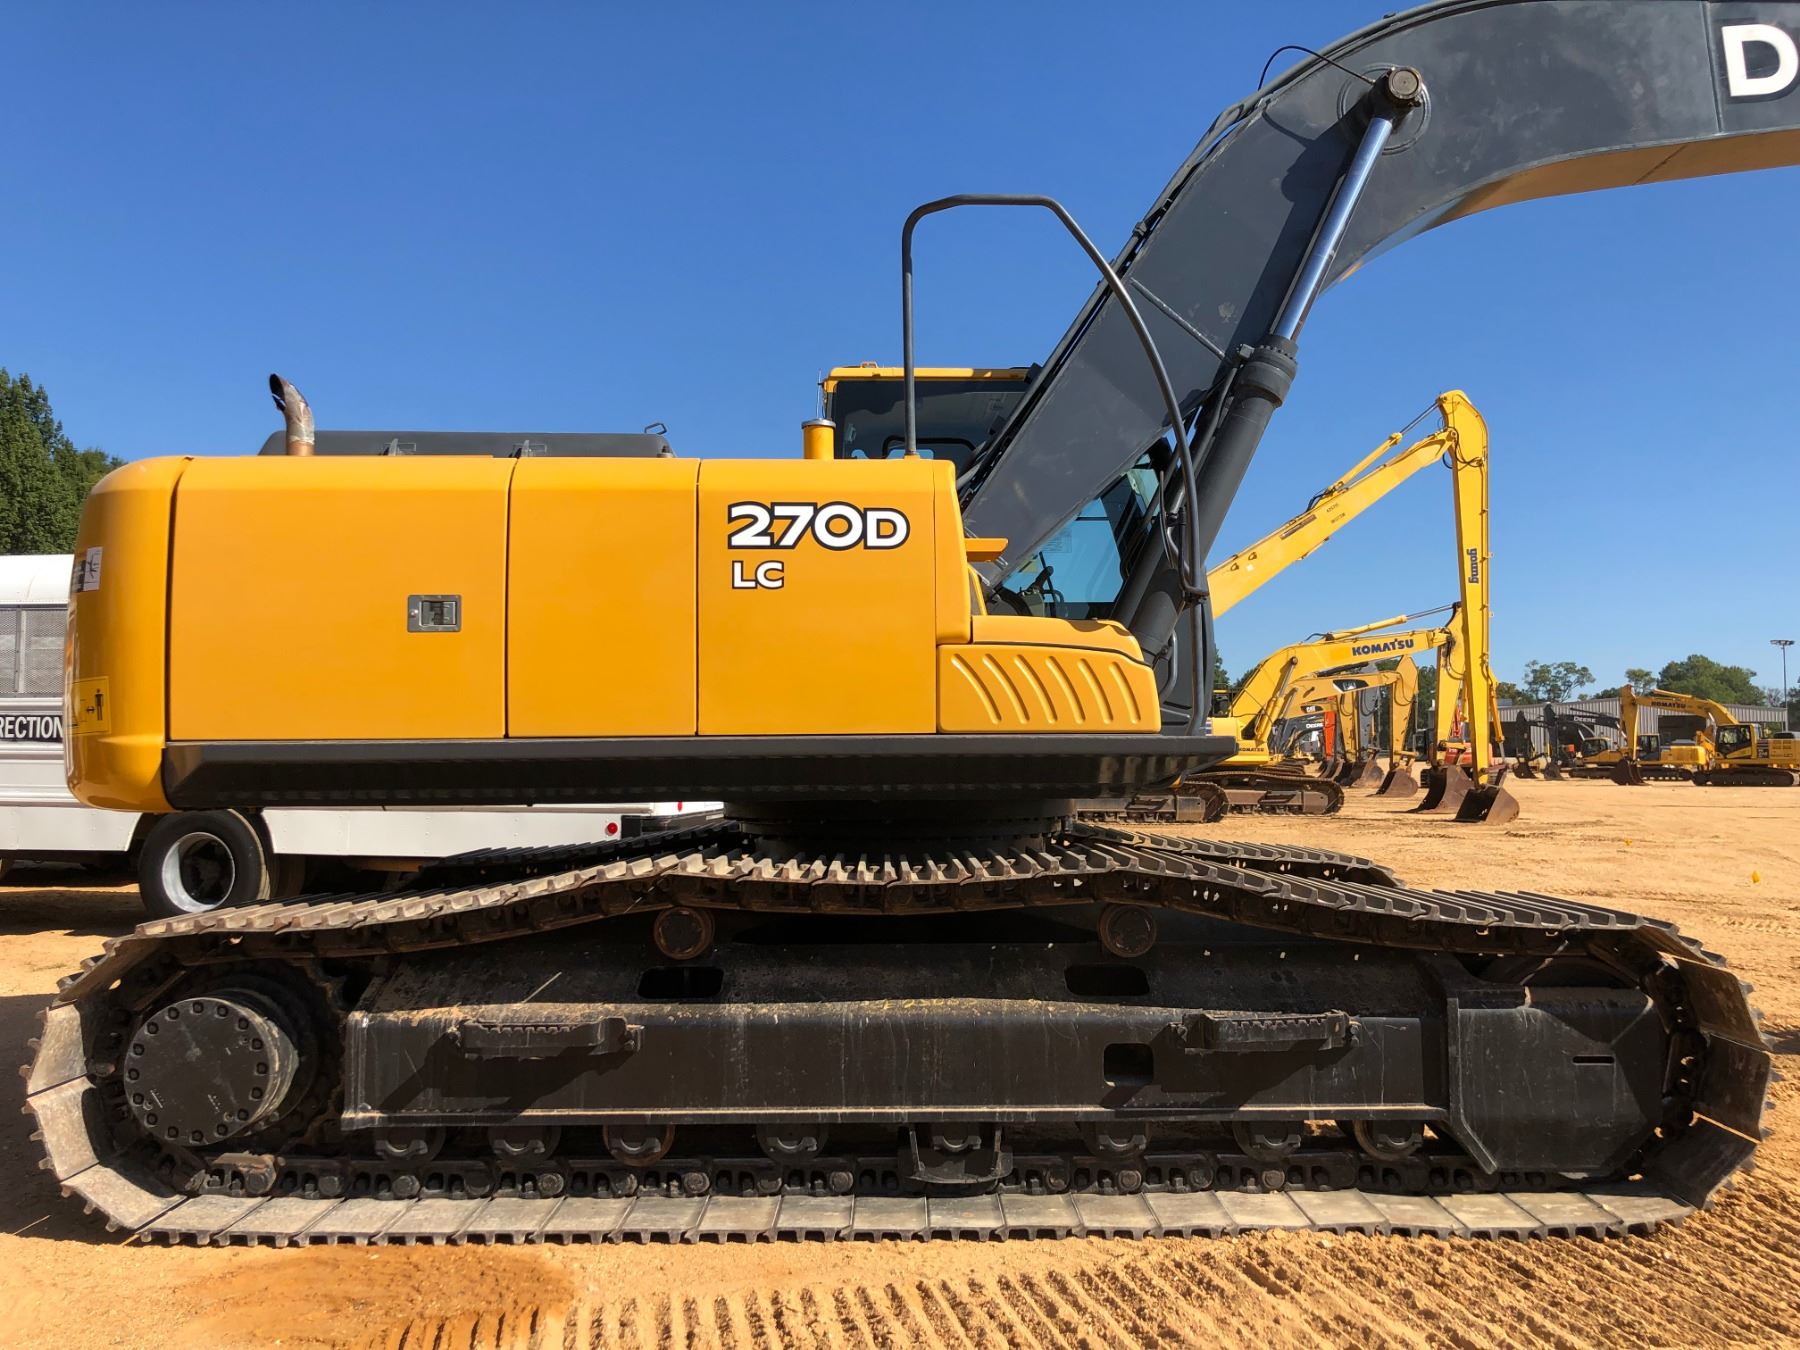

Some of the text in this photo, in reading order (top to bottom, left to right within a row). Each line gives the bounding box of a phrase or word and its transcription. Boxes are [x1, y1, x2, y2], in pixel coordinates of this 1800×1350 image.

[1721, 23, 1799, 97] D
[728, 501, 910, 551] 270D
[732, 560, 785, 590] LC
[1352, 638, 1414, 656] KOMATSU
